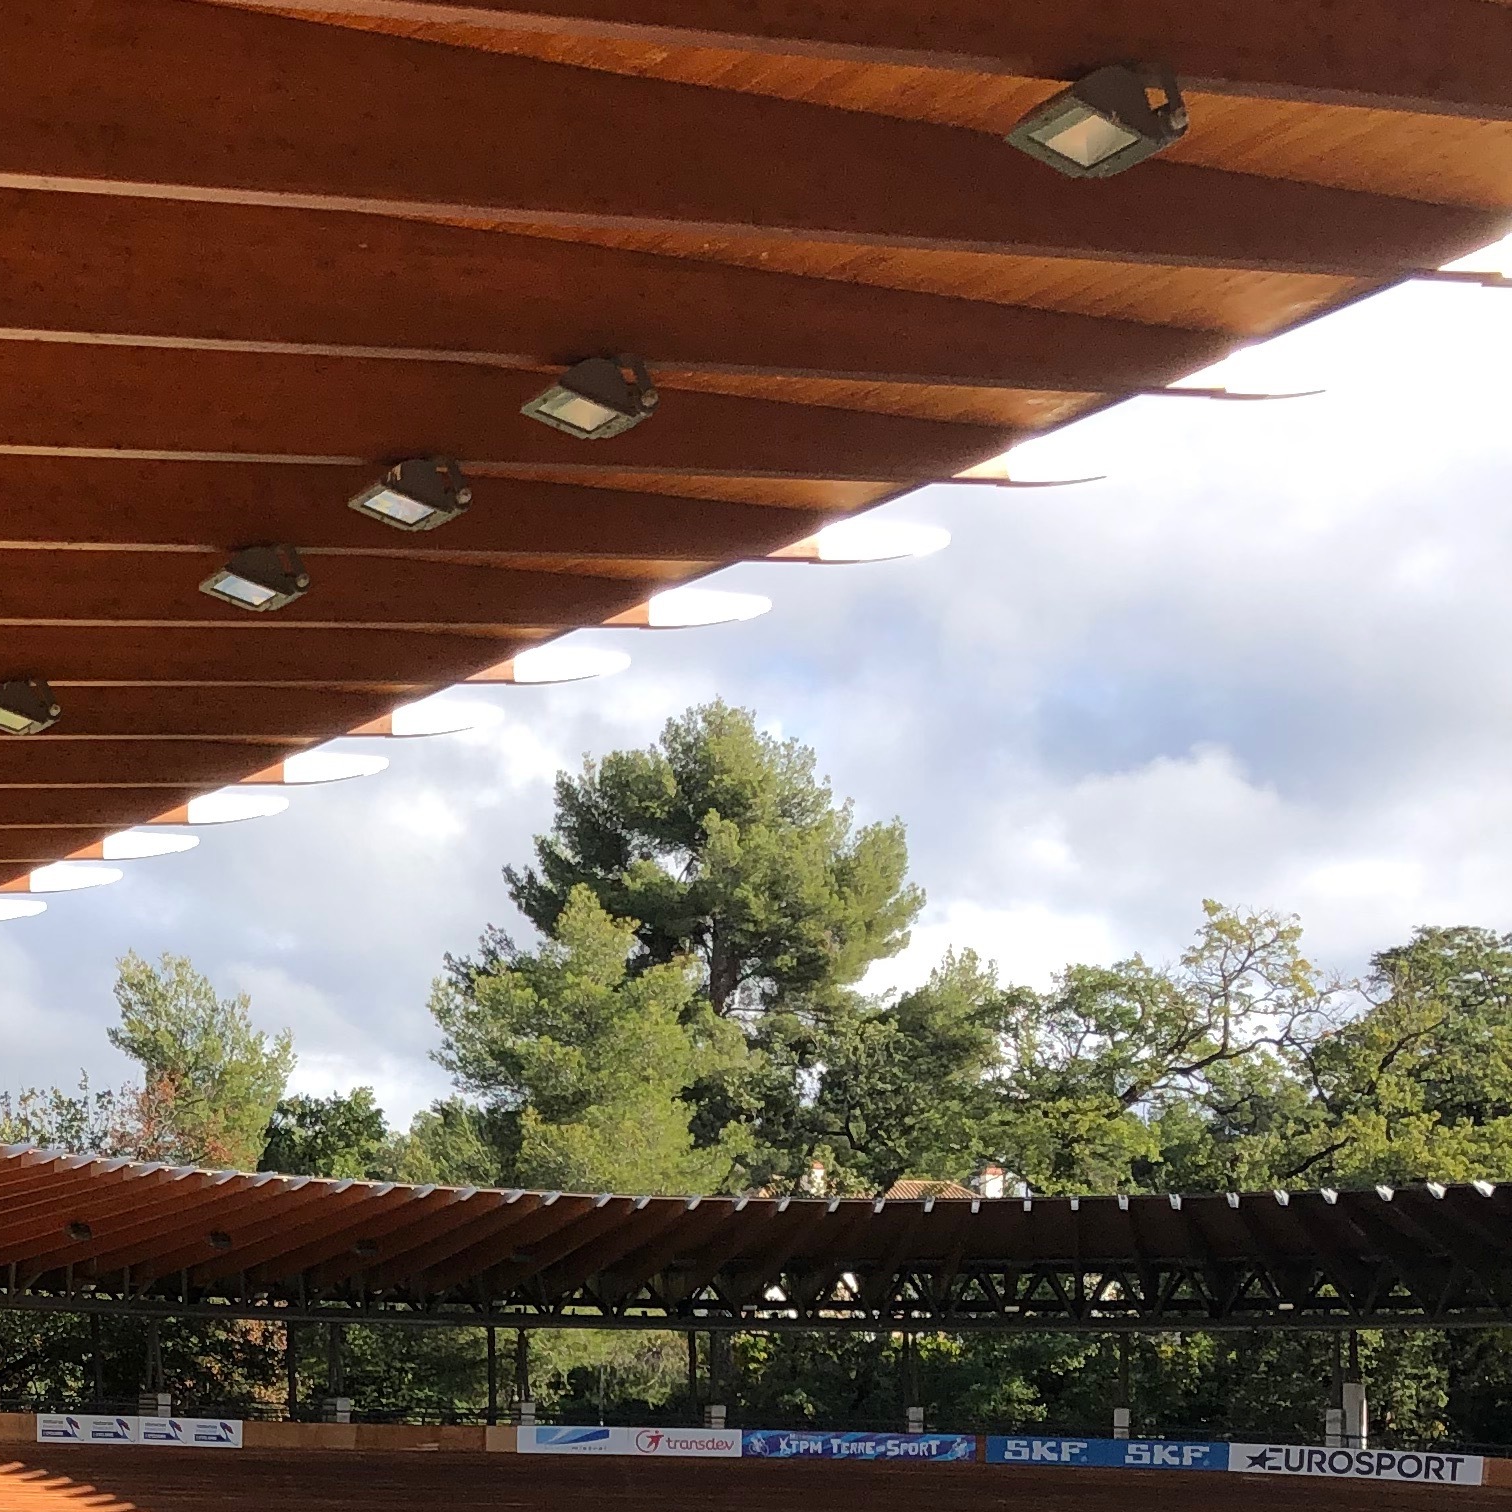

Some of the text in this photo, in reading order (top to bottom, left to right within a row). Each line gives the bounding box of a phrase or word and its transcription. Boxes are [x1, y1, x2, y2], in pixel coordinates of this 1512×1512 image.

[665, 1436, 735, 1451] transdev
[1004, 1440, 1088, 1461] SKF
[1124, 1444, 1210, 1465] SKF
[1246, 1447, 1465, 1482] EUROSPORT
